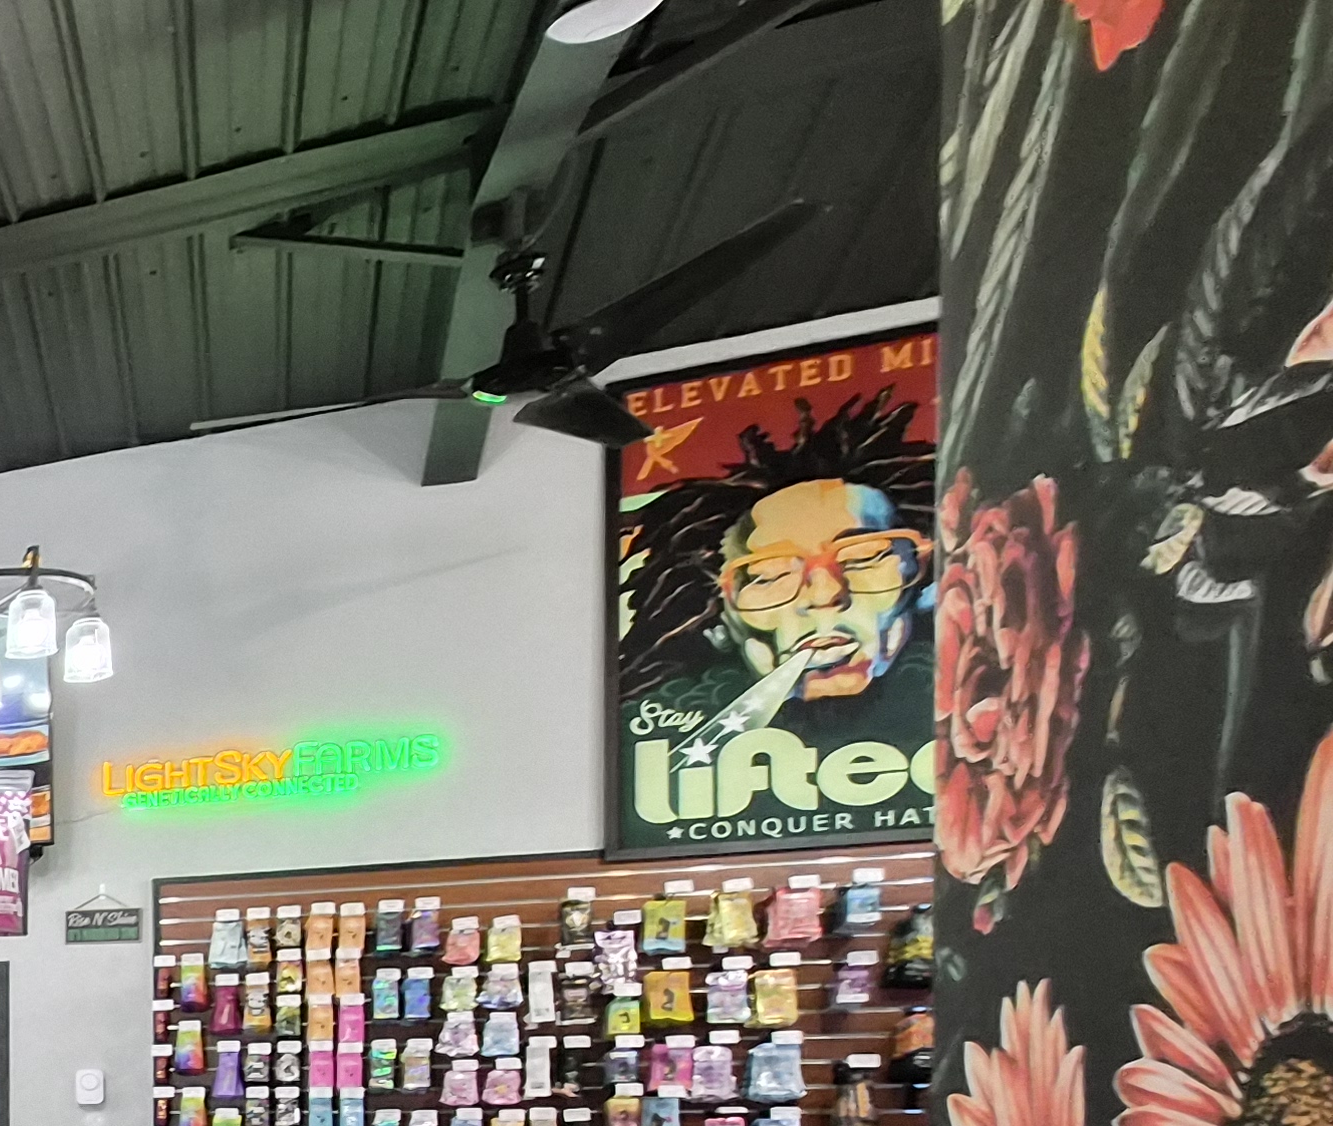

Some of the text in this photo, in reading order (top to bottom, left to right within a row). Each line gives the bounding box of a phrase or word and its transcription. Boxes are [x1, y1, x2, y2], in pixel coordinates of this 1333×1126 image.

[626, 354, 854, 417] ELEVATED
[629, 700, 705, 735] Stay
[242, 773, 359, 799] CONNECTED
[688, 812, 854, 840] CONQUER
